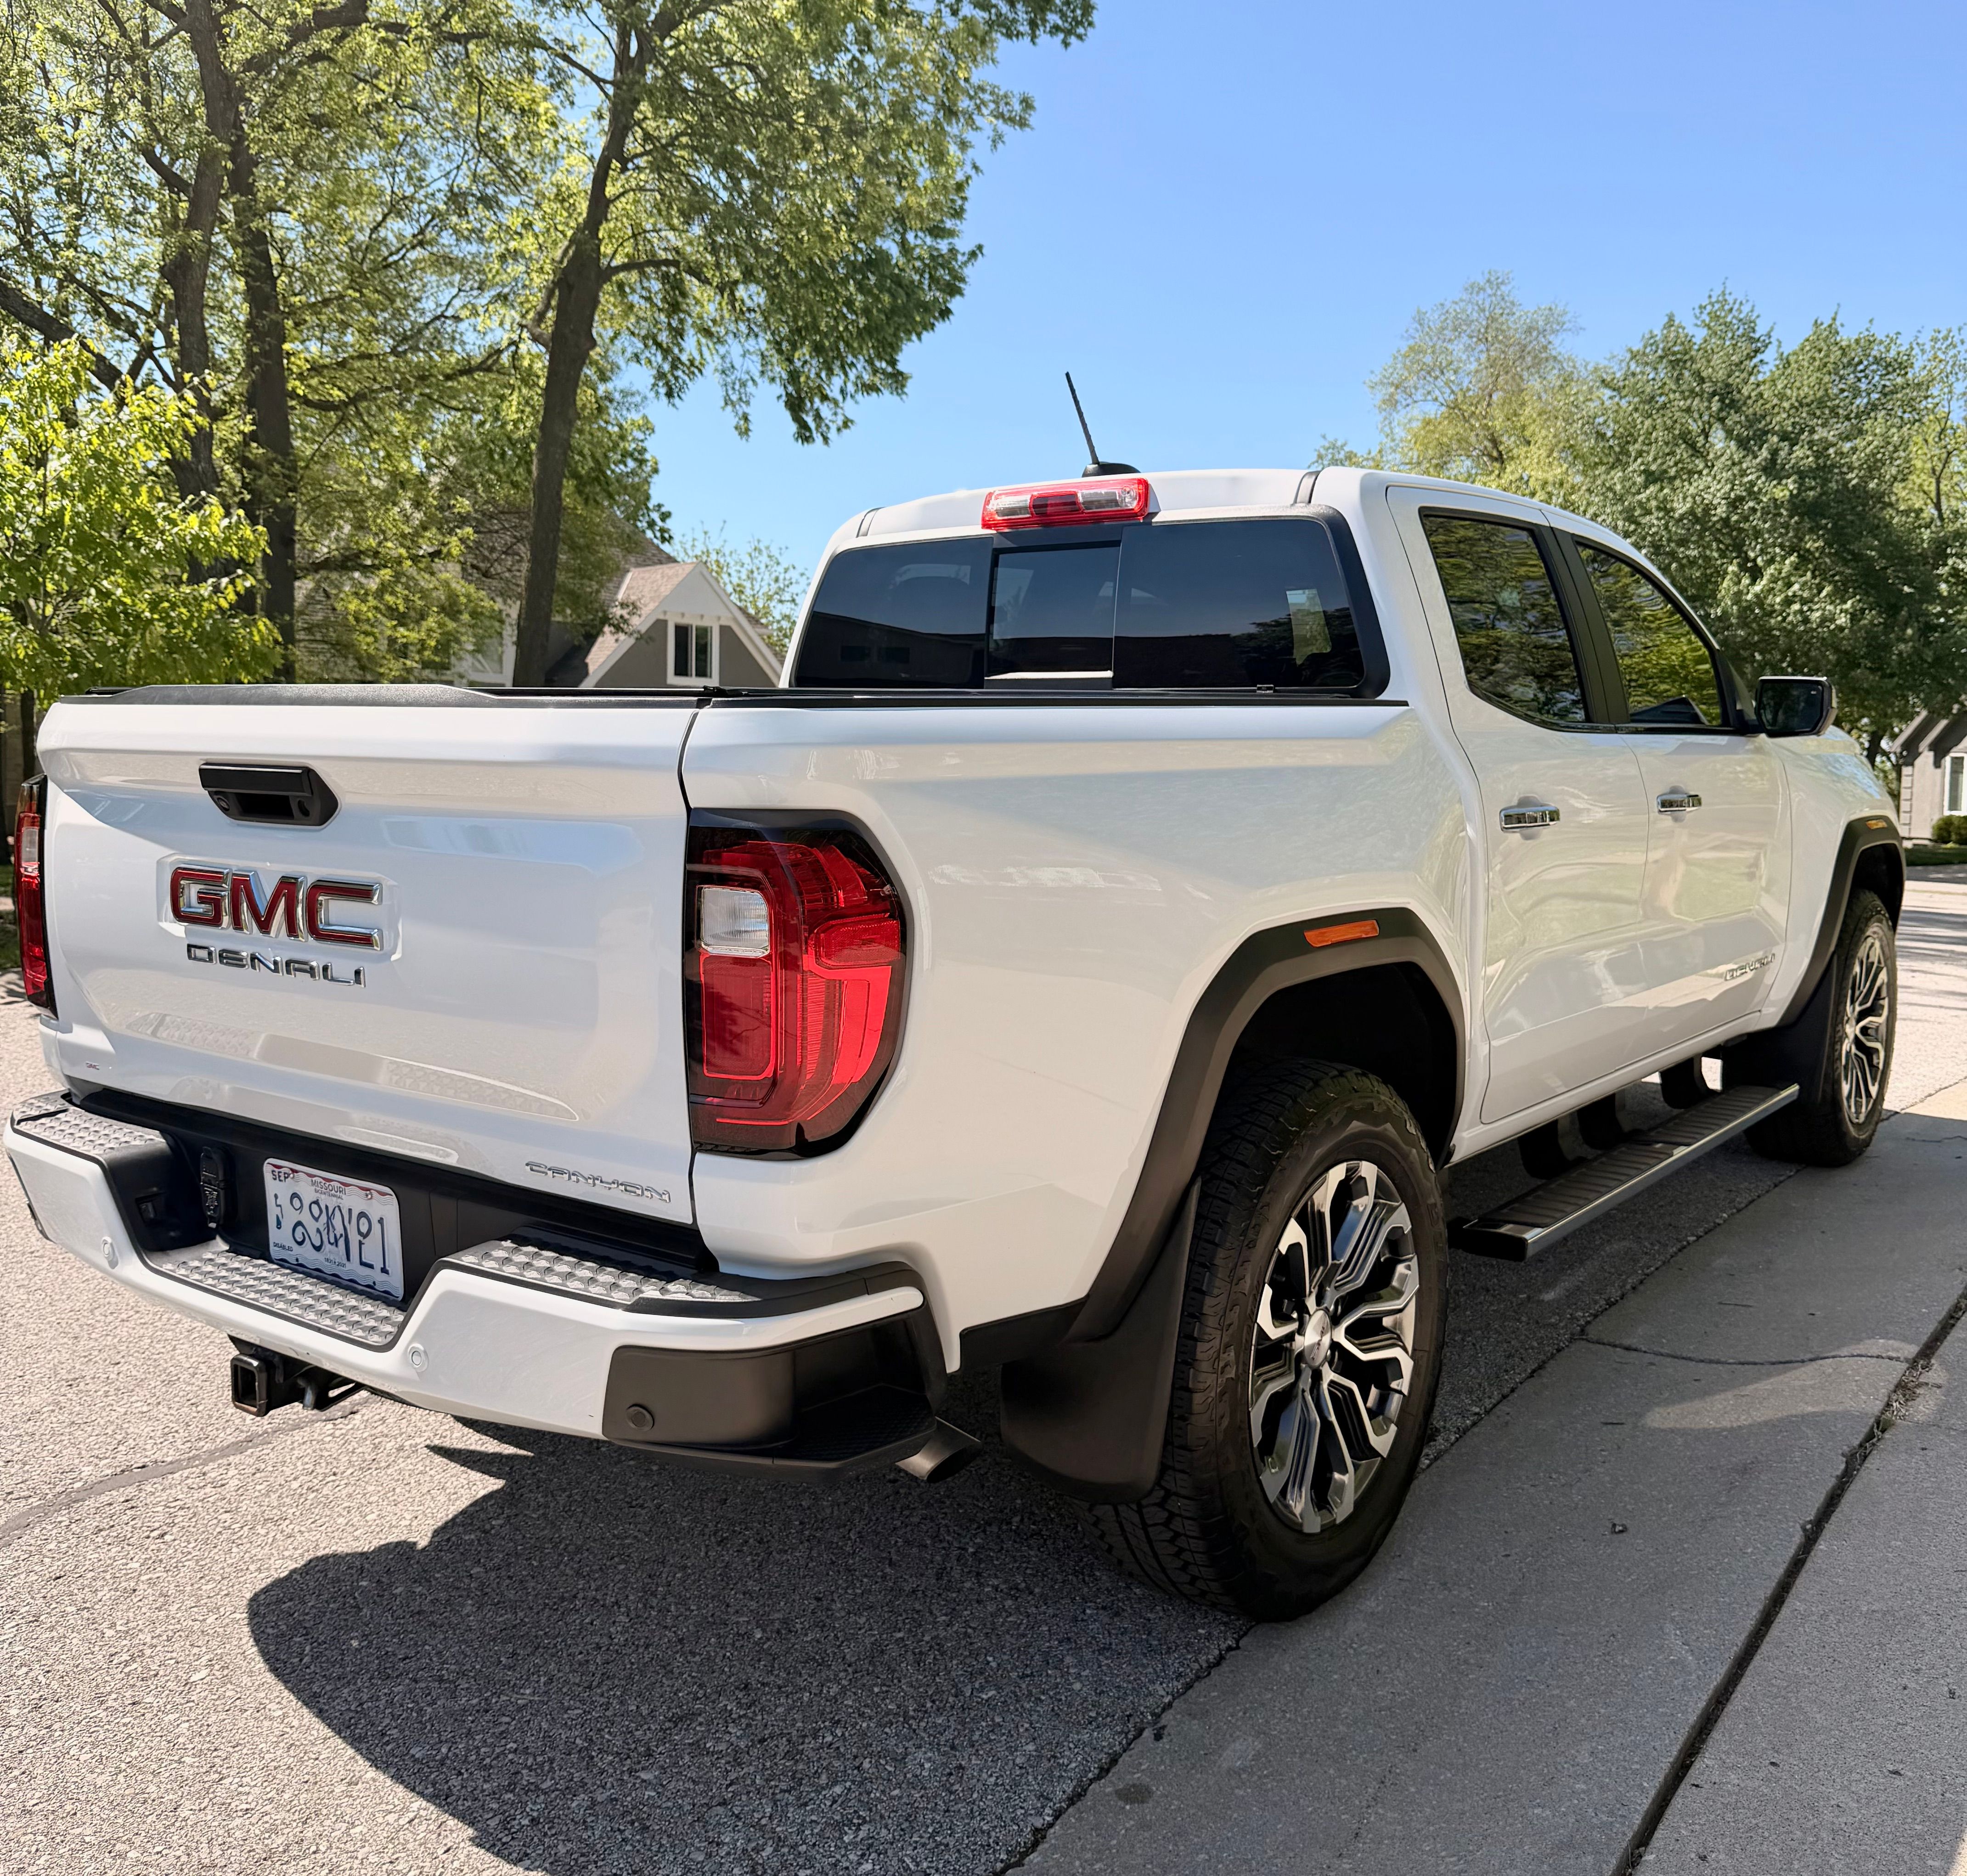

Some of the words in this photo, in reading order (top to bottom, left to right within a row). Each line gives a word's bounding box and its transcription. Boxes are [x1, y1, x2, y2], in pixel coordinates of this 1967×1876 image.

[170, 865, 383, 951] GMC
[187, 943, 366, 988] DENALI
[271, 1170, 289, 1183] SEP
[525, 1161, 671, 1203] CANYON
[311, 1179, 346, 1195] MISSOURI
[315, 1188, 344, 1200] BICENTENNIAL
[273, 1242, 293, 1252] DISABLED
